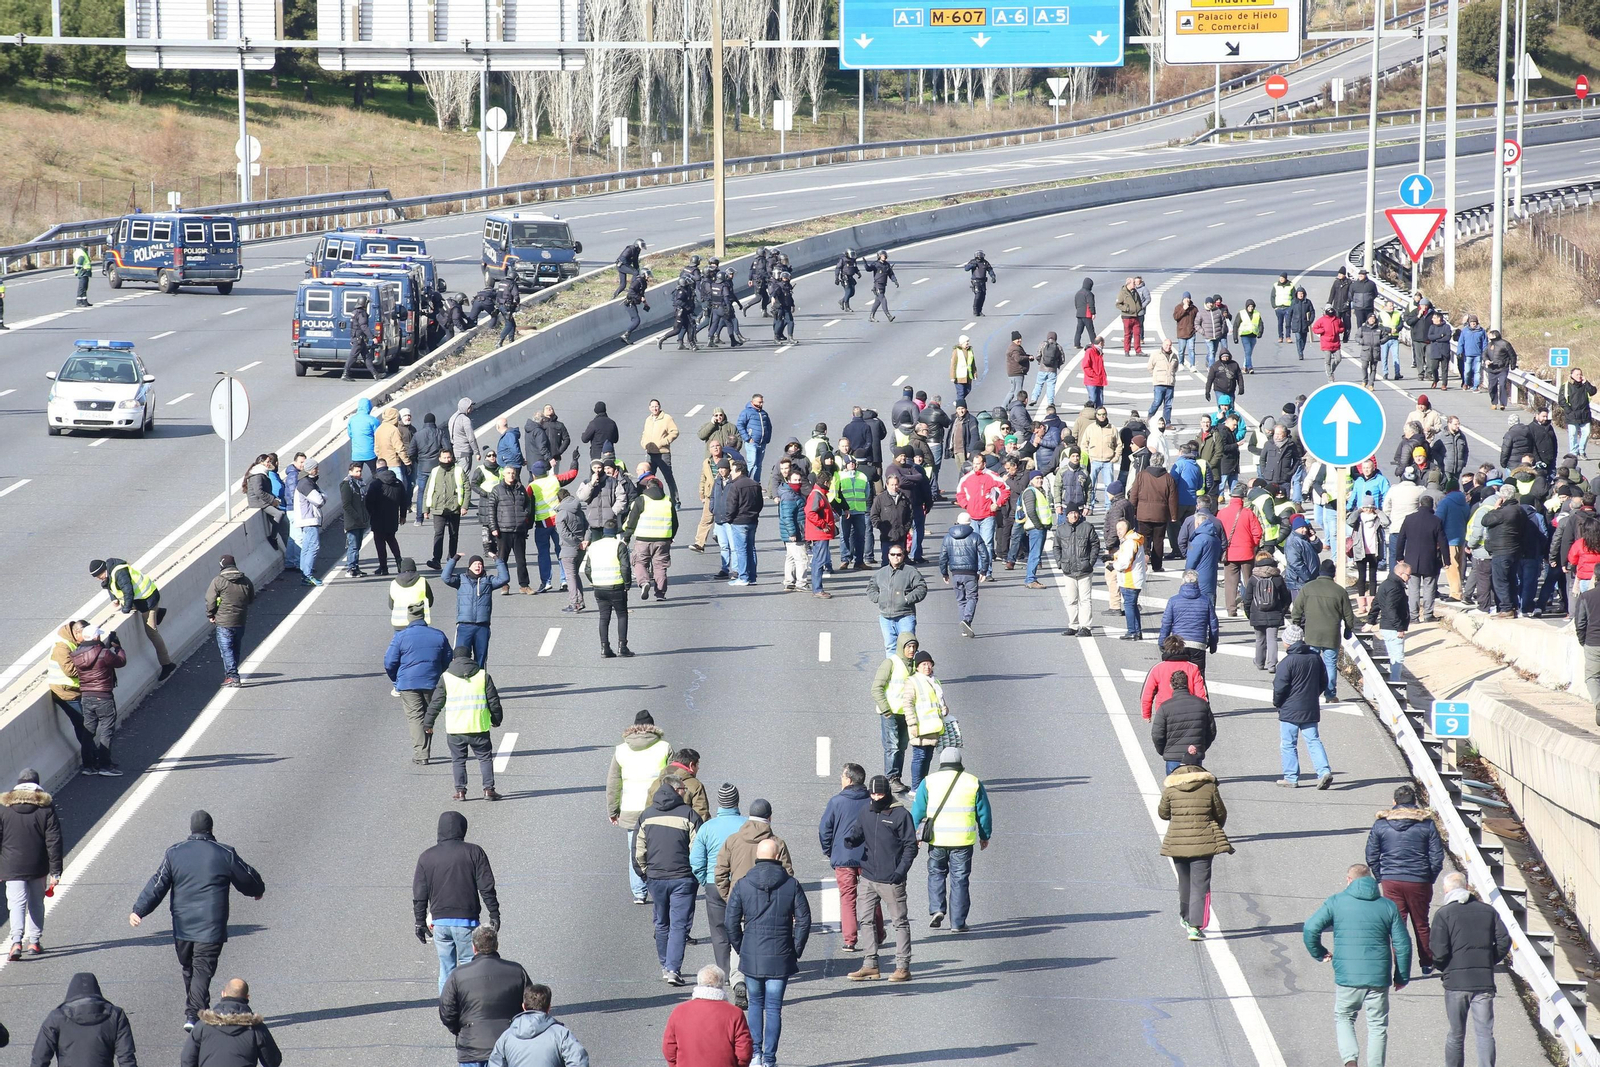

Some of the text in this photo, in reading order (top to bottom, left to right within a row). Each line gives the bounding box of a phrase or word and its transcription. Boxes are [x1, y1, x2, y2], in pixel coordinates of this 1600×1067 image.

[896, 9, 1066, 24] A-1 M-607 A-6 A-5
[1198, 13, 1233, 21] Palacio
[1237, 12, 1248, 20] de
[1211, 23, 1259, 31] Comercial
[134, 243, 165, 263] POLICIA
[302, 320, 334, 328] POLICIA
[1556, 357, 1563, 365] 8
[1448, 703, 1456, 712] 6
[1445, 718, 1459, 734] 9
